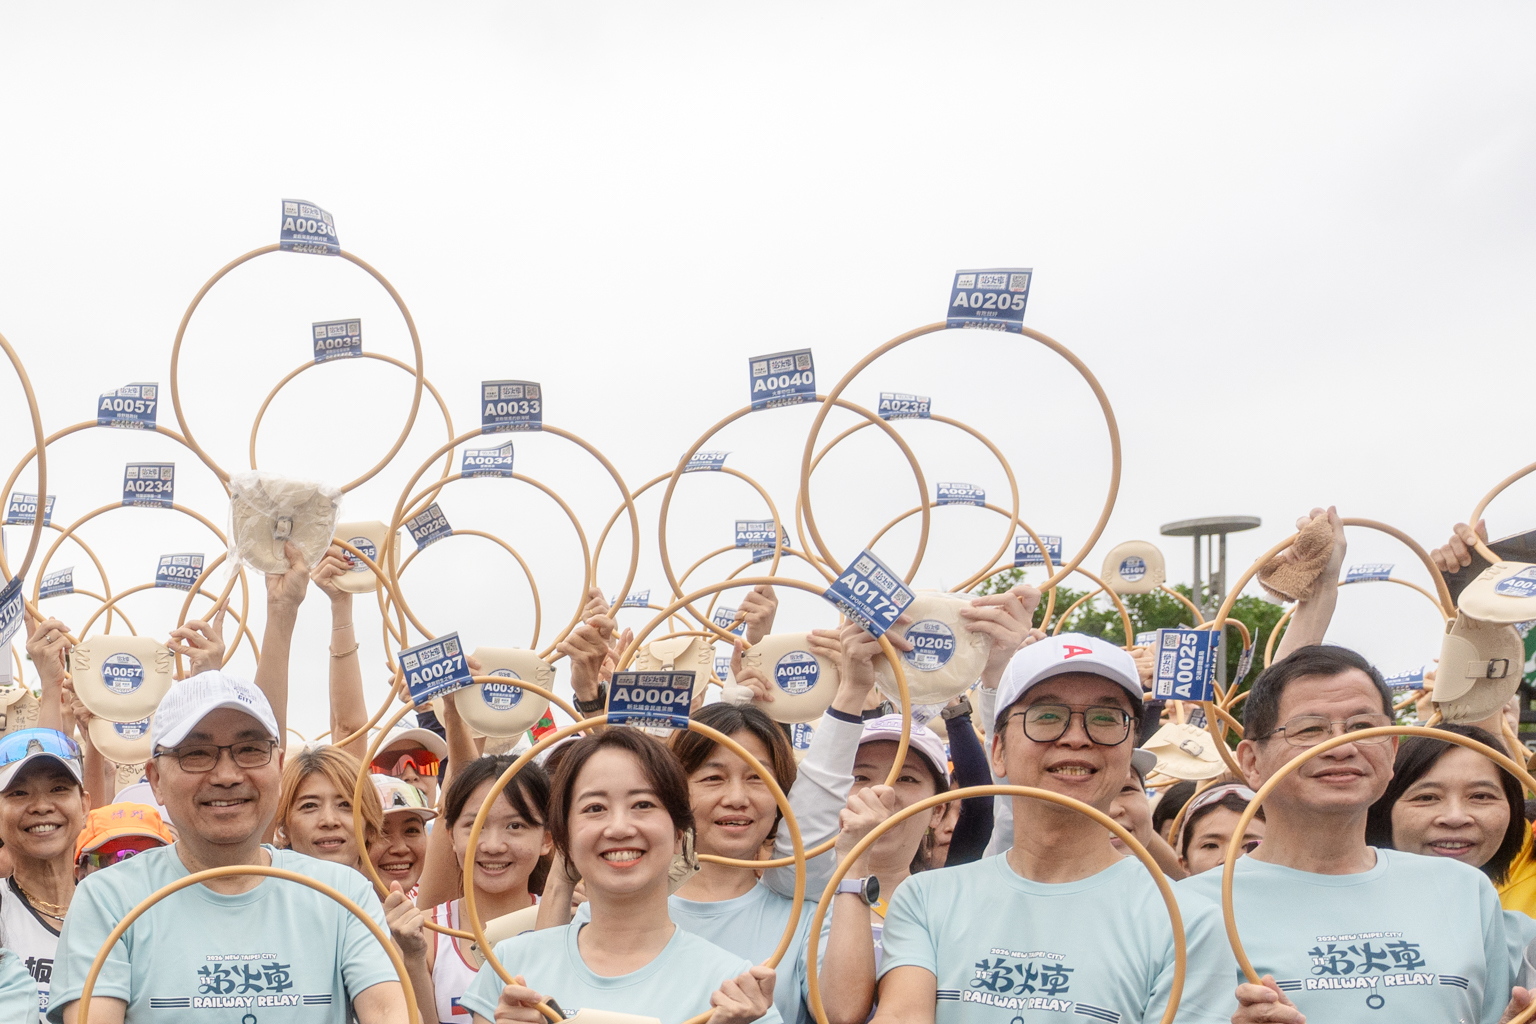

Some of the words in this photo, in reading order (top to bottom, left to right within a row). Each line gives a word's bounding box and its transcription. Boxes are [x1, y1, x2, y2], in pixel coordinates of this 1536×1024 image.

[283, 217, 336, 237] A0030
[953, 292, 1026, 311] A0205
[316, 336, 361, 351] A0035
[754, 371, 814, 393] A0040
[101, 398, 156, 414] A0057
[484, 400, 540, 418] A0033
[880, 400, 928, 413] A0238
[464, 454, 513, 465] A0034
[125, 481, 173, 493] A0234
[10, 503, 51, 514] A004
[414, 515, 447, 541] A0226
[736, 531, 776, 539] A0279
[344, 547, 375, 559] A035
[158, 565, 201, 580] A0203
[41, 575, 72, 588] A0249
[840, 570, 901, 624] A0172
[907, 634, 953, 651] A0205
[104, 666, 143, 677] A0057
[410, 654, 464, 688] A0027
[777, 664, 818, 677] A0040
[1175, 632, 1198, 698] A0025
[484, 683, 521, 695] A0033
[613, 686, 690, 707] A0004
[1316, 935, 1338, 943] 2026
[1338, 934, 1357, 942] NEW
[1358, 932, 1383, 941] TAIPEI
[205, 954, 223, 962] 2026
[224, 953, 240, 961] NEW
[240, 953, 261, 961] TAIPEI
[261, 952, 278, 960] CITY
[990, 947, 1010, 956] 2026
[1010, 951, 1028, 959] NEW
[1047, 952, 1066, 961] CITY
[1306, 976, 1381, 990] RAILWAY
[1383, 972, 1435, 988] RELAY
[193, 996, 255, 1009] RAILWAY
[257, 994, 300, 1008] RELAY
[963, 989, 1027, 1010] RAILWAY
[1027, 996, 1073, 1013] RELAY
